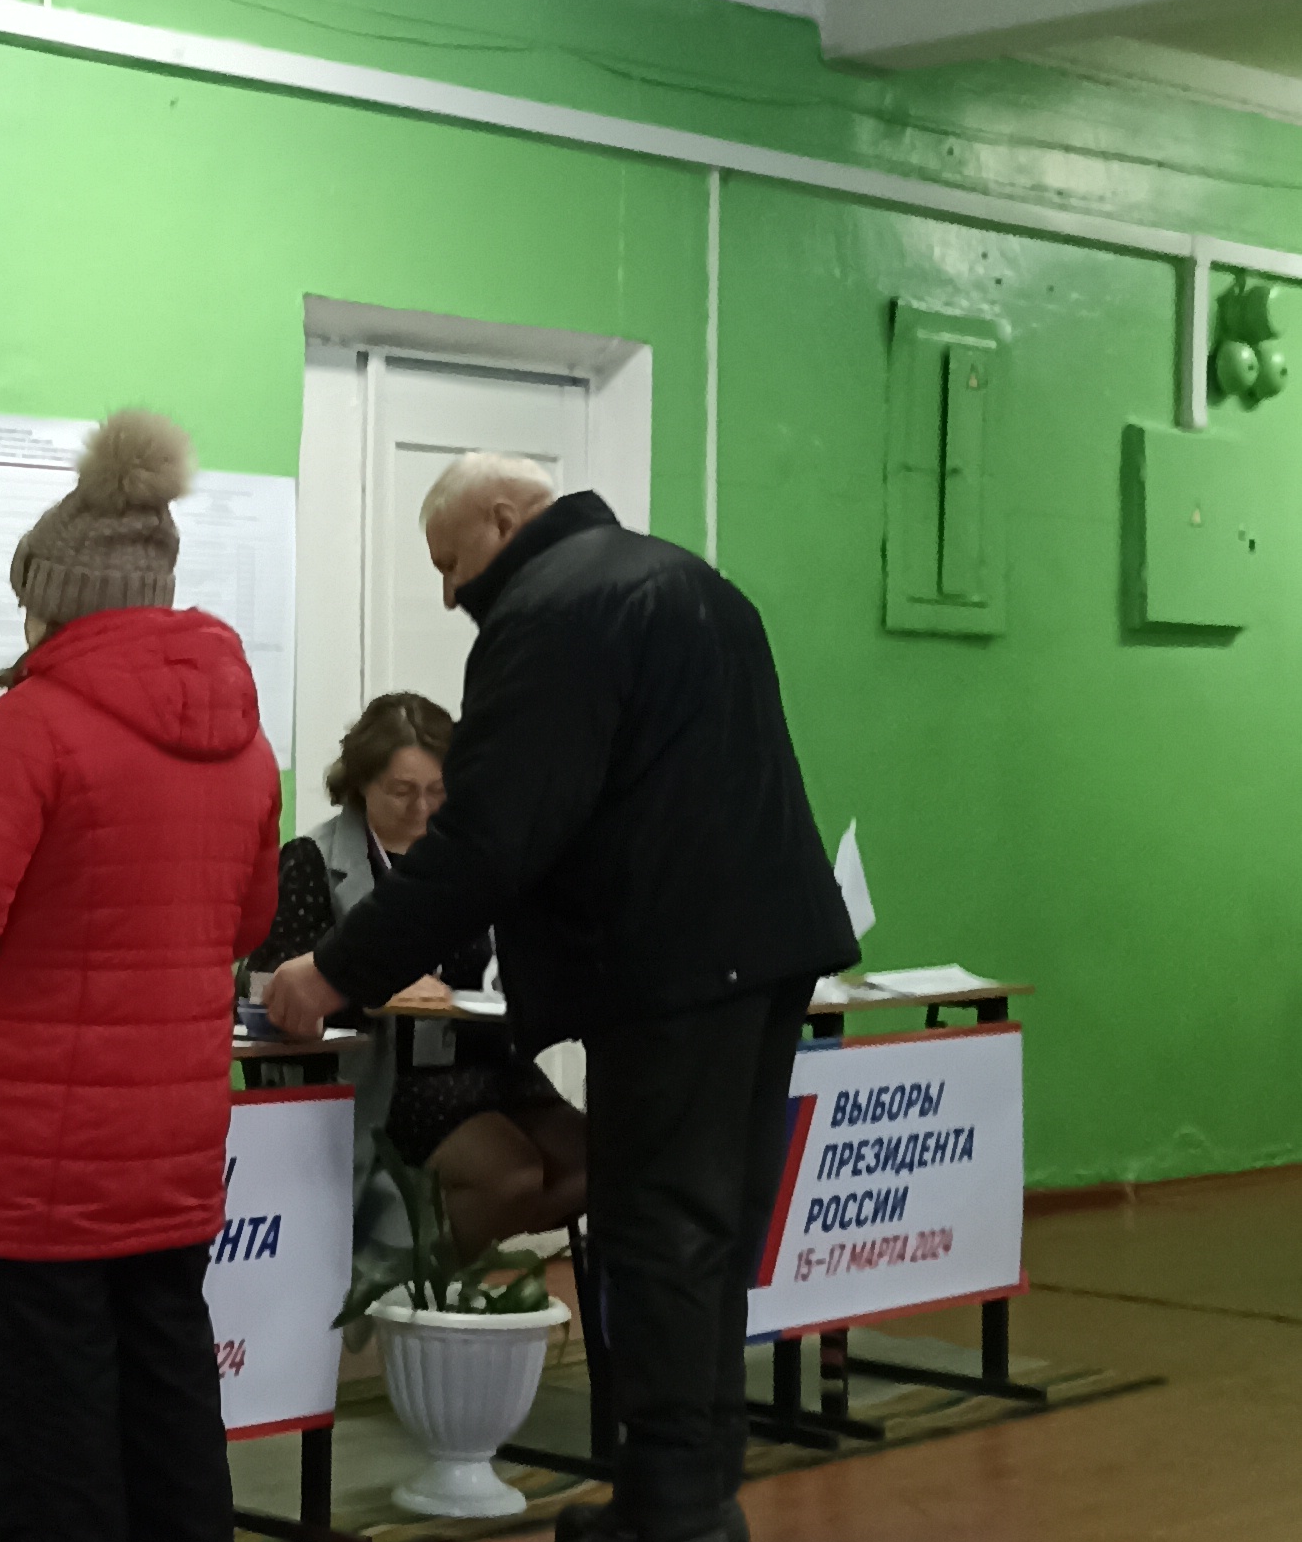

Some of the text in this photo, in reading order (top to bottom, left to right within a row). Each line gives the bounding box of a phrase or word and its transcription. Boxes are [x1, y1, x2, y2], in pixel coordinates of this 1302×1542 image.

[831, 1080, 946, 1129] ВЫБОРЫ
[816, 1125, 975, 1181] ПРЕЗИДЕНТА
[803, 1185, 910, 1235] РОССИИ
[845, 1235, 909, 1274] МАРТА
[909, 1227, 954, 1264] 2024
